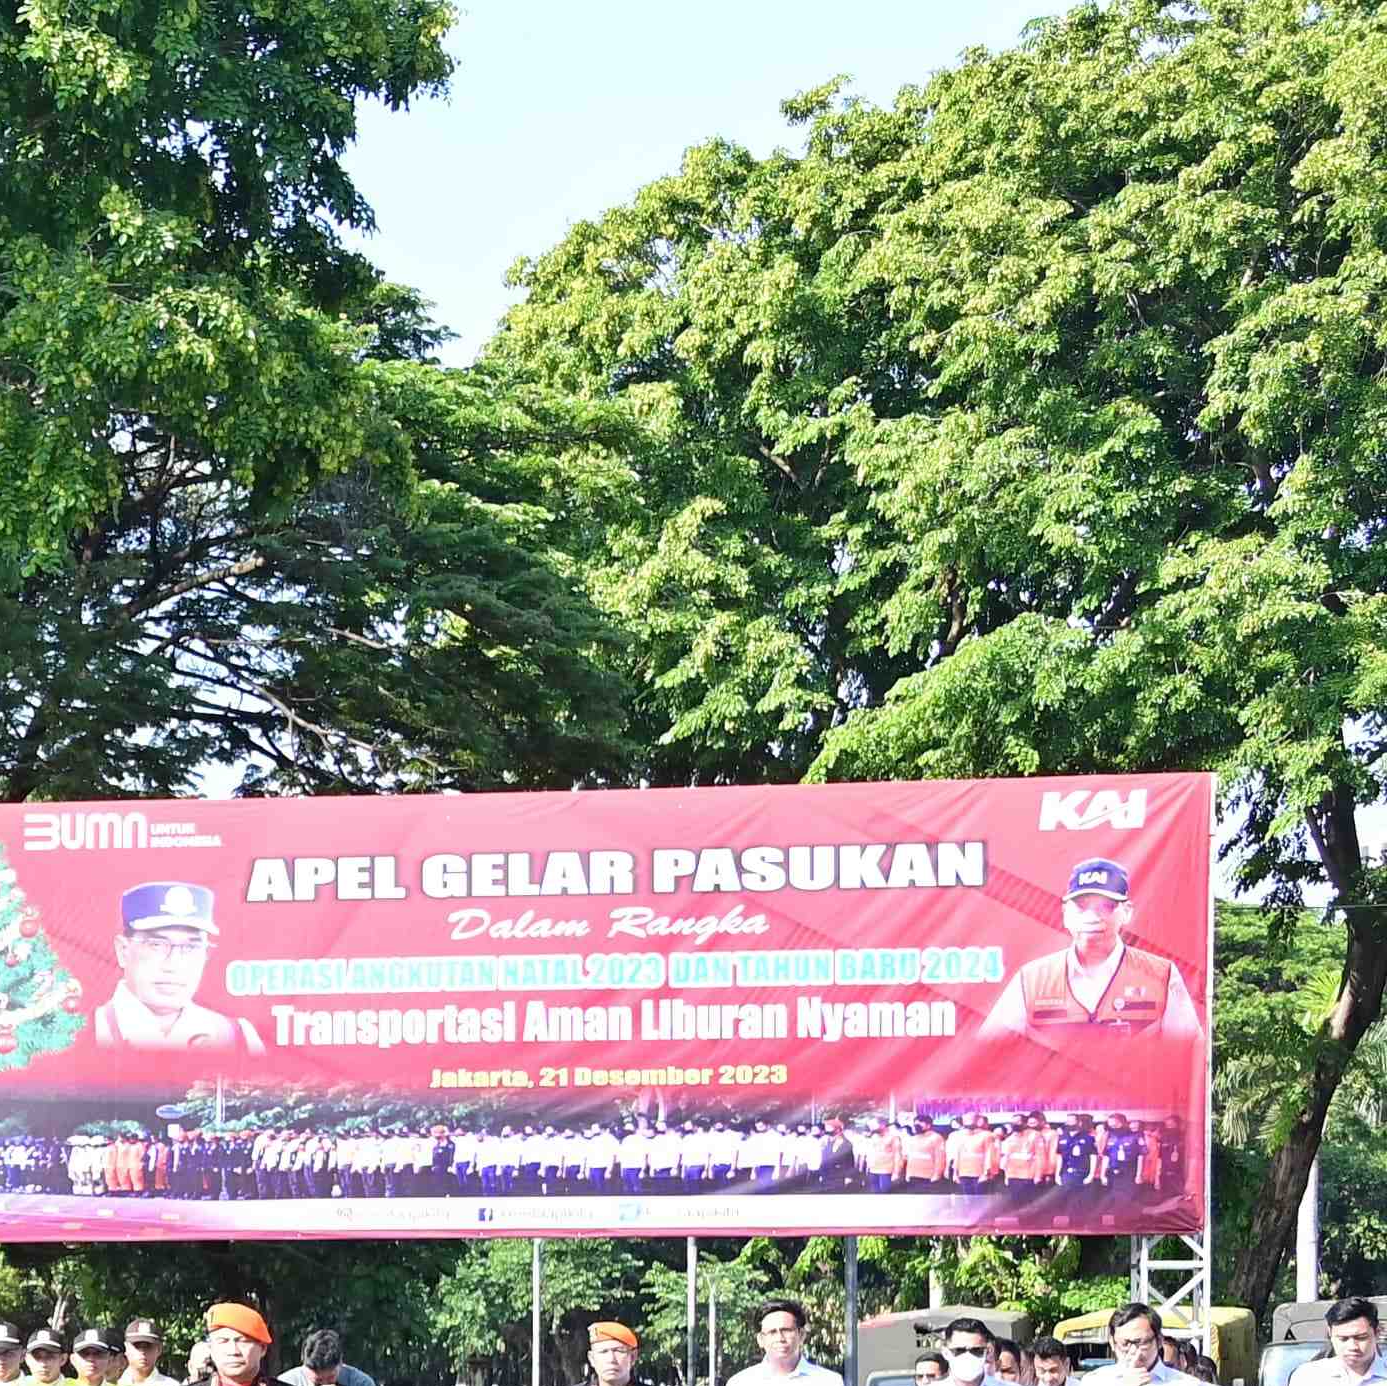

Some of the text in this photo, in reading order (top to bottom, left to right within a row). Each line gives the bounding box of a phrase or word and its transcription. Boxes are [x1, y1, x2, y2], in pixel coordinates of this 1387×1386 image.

[1038, 789, 1148, 831] KAI
[245, 840, 987, 903] APEL GELAR PASUKAN
[1079, 871, 1107, 885] KAI
[447, 904, 770, 944] Dalam Rangka
[228, 960, 345, 994] OPERASI
[347, 957, 496, 992] ANGKUTAN
[498, 955, 584, 991] NATAL
[586, 953, 665, 989] 2023
[735, 950, 833, 986] TAHUN
[834, 948, 919, 984] BARU
[921, 946, 1003, 983] 2024
[271, 996, 955, 1048] Transportasi Aman Liburan Nyaman
[430, 1063, 788, 1089] Jakarta, 21 Desember 2023
